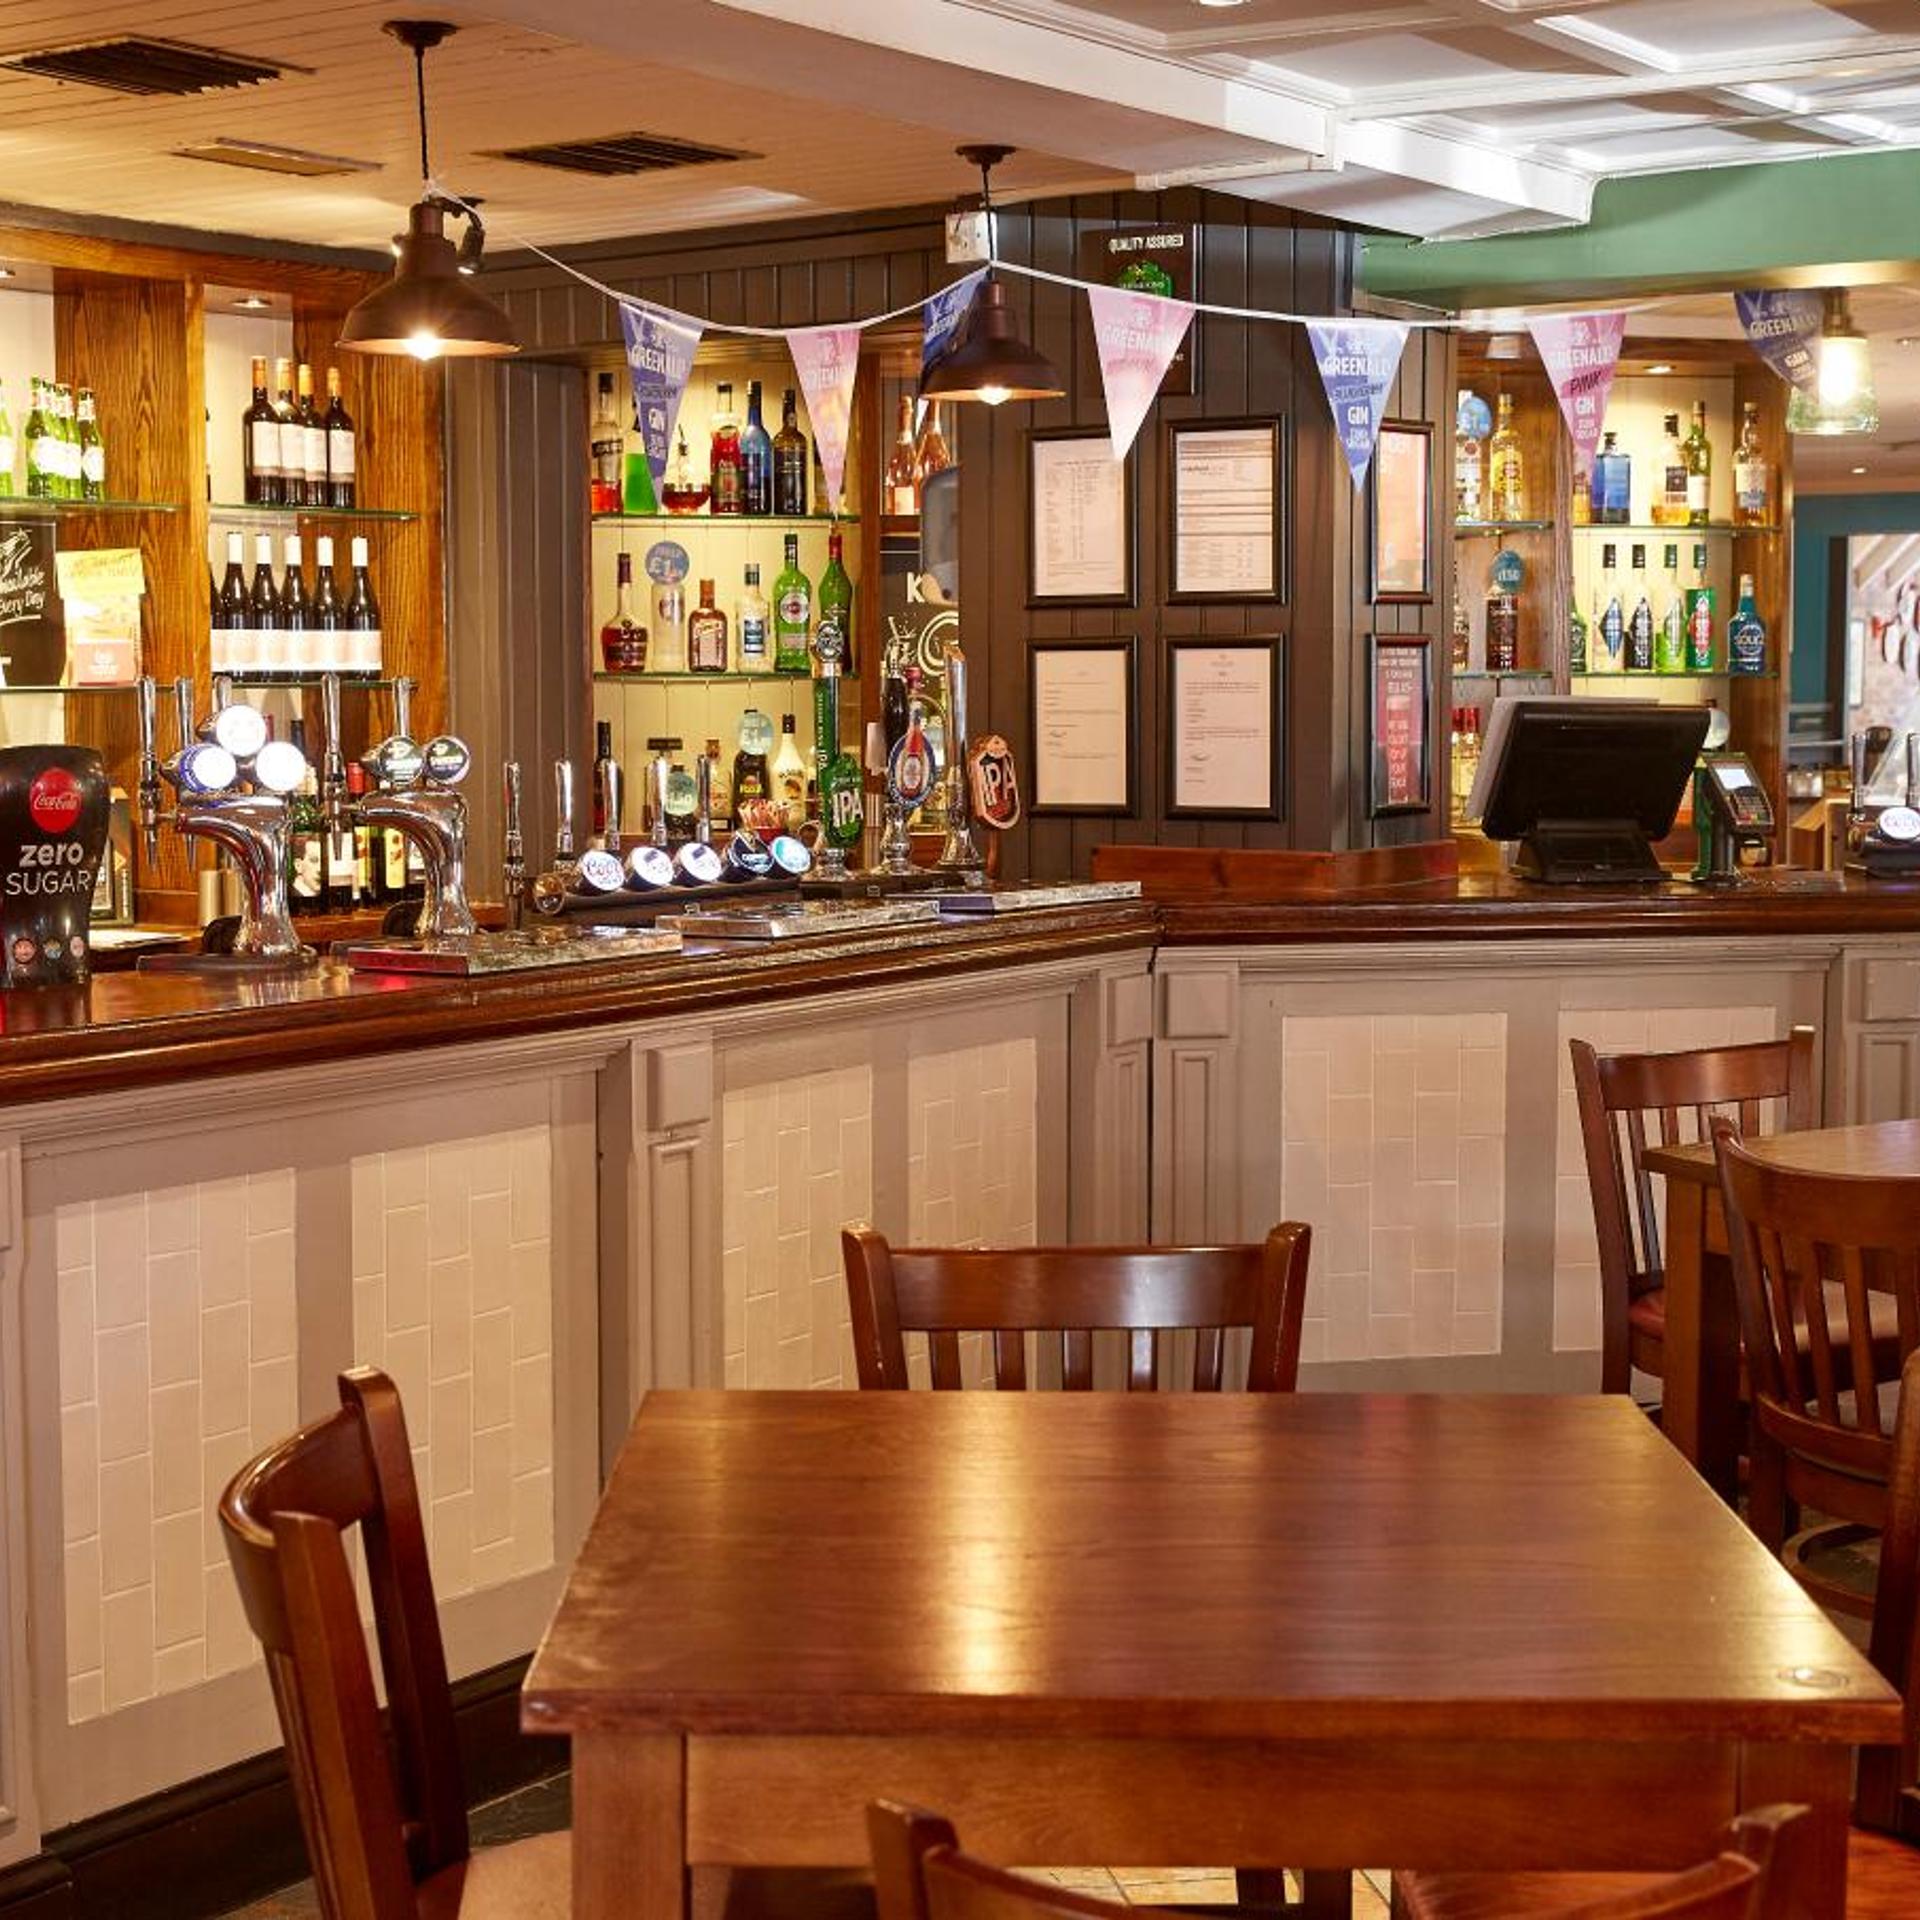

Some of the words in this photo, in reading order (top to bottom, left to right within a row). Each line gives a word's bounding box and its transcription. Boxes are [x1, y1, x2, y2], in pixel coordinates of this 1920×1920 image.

[1108, 237, 1143, 254] QUALITY
[1569, 370, 1602, 395] PINK
[1347, 406, 1369, 425] GIN
[984, 754, 1018, 806] IPA
[832, 787, 864, 828] IPA
[19, 841, 84, 867] zero
[5, 869, 92, 896] SUGAR
